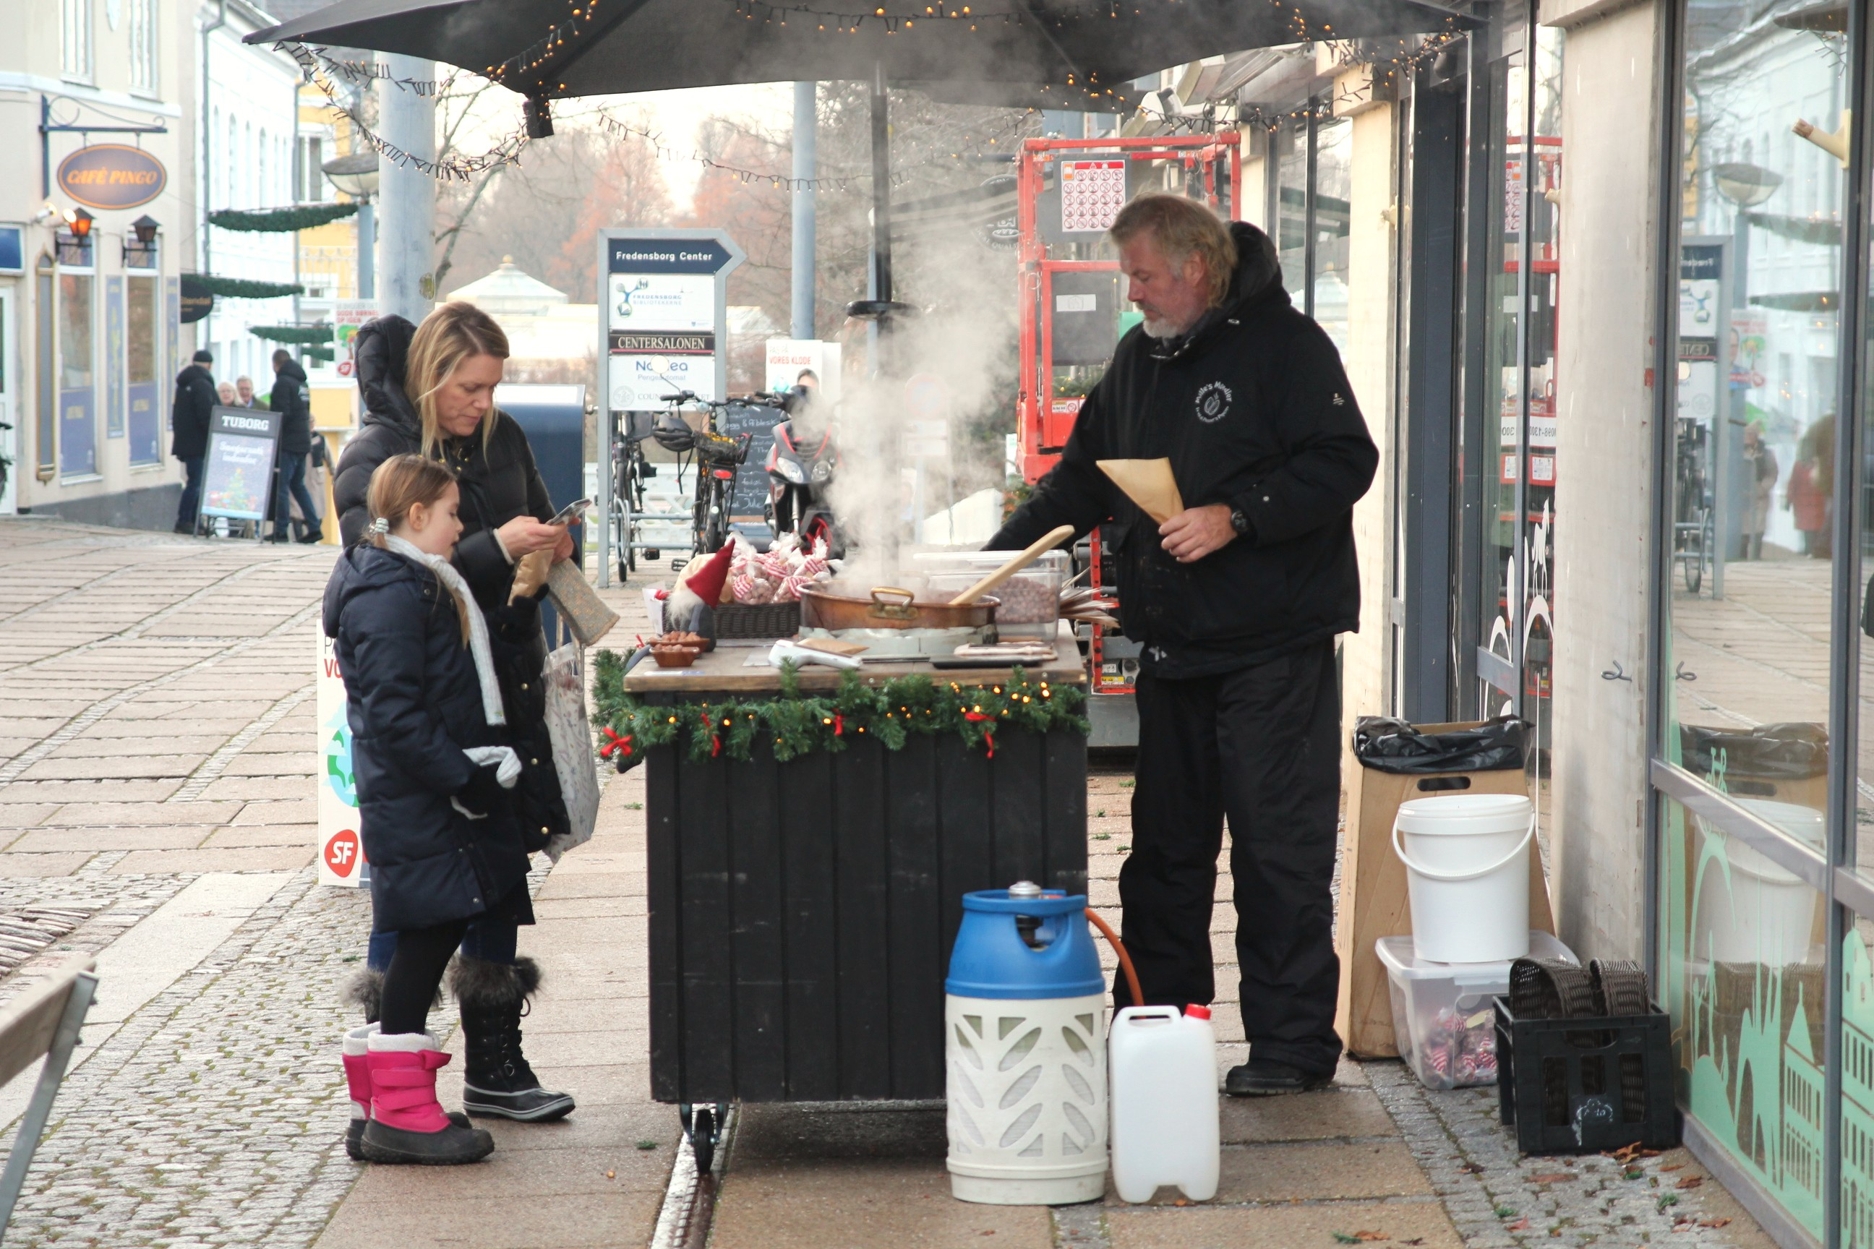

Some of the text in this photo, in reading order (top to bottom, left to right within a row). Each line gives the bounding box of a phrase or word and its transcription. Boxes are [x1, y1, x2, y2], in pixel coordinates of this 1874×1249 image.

[109, 170, 158, 185] PINGO
[615, 251, 713, 263] Fredensborg Center
[618, 336, 705, 350] CENTERSALONEN
[635, 360, 688, 372] Noea
[769, 356, 812, 365] VORES KLODE
[222, 415, 270, 431] TUBORG
[330, 841, 354, 865] SF
